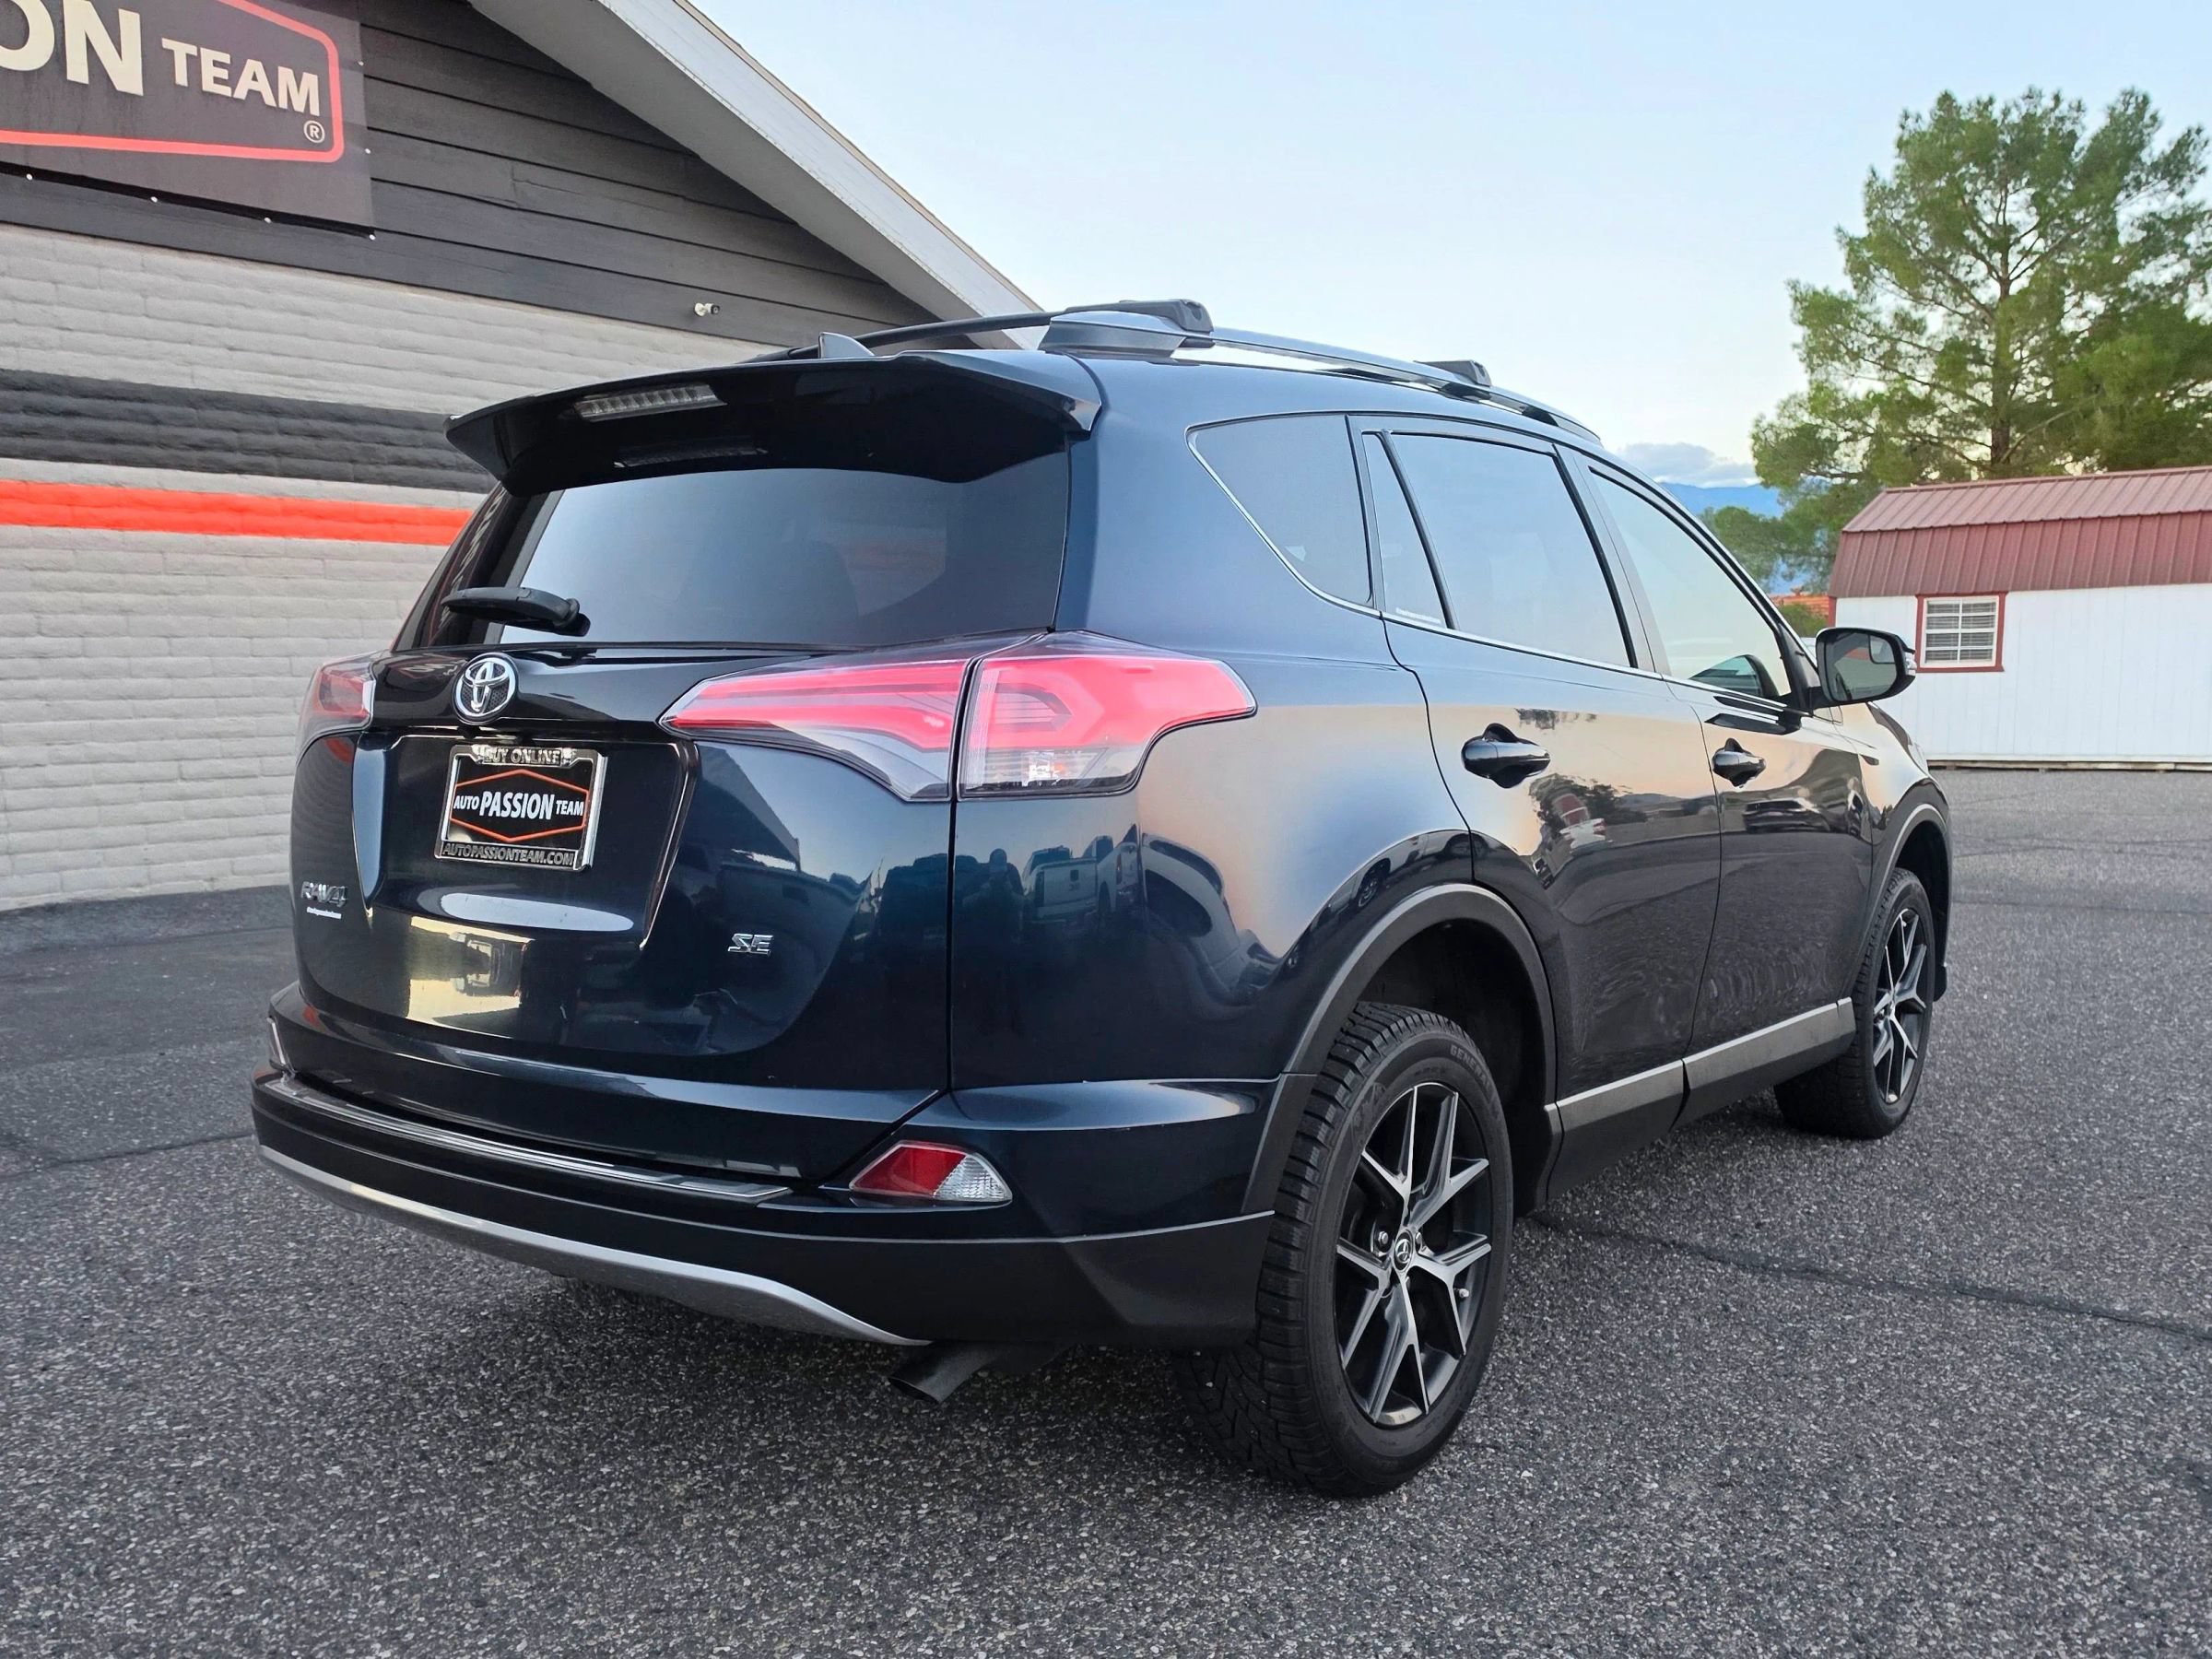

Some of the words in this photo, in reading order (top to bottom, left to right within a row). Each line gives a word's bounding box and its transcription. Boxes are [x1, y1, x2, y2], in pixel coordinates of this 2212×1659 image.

[0, 0, 144, 97] ON
[161, 37, 320, 117] TEAM
[511, 747, 561, 765] ONLINE
[453, 795, 480, 810] AUTO
[479, 791, 555, 819] PASSION
[556, 800, 584, 816] TEAM
[442, 842, 573, 865] AUTOPASSIONTEAM.COM
[300, 881, 347, 908] RAV4
[728, 933, 773, 955] SE
